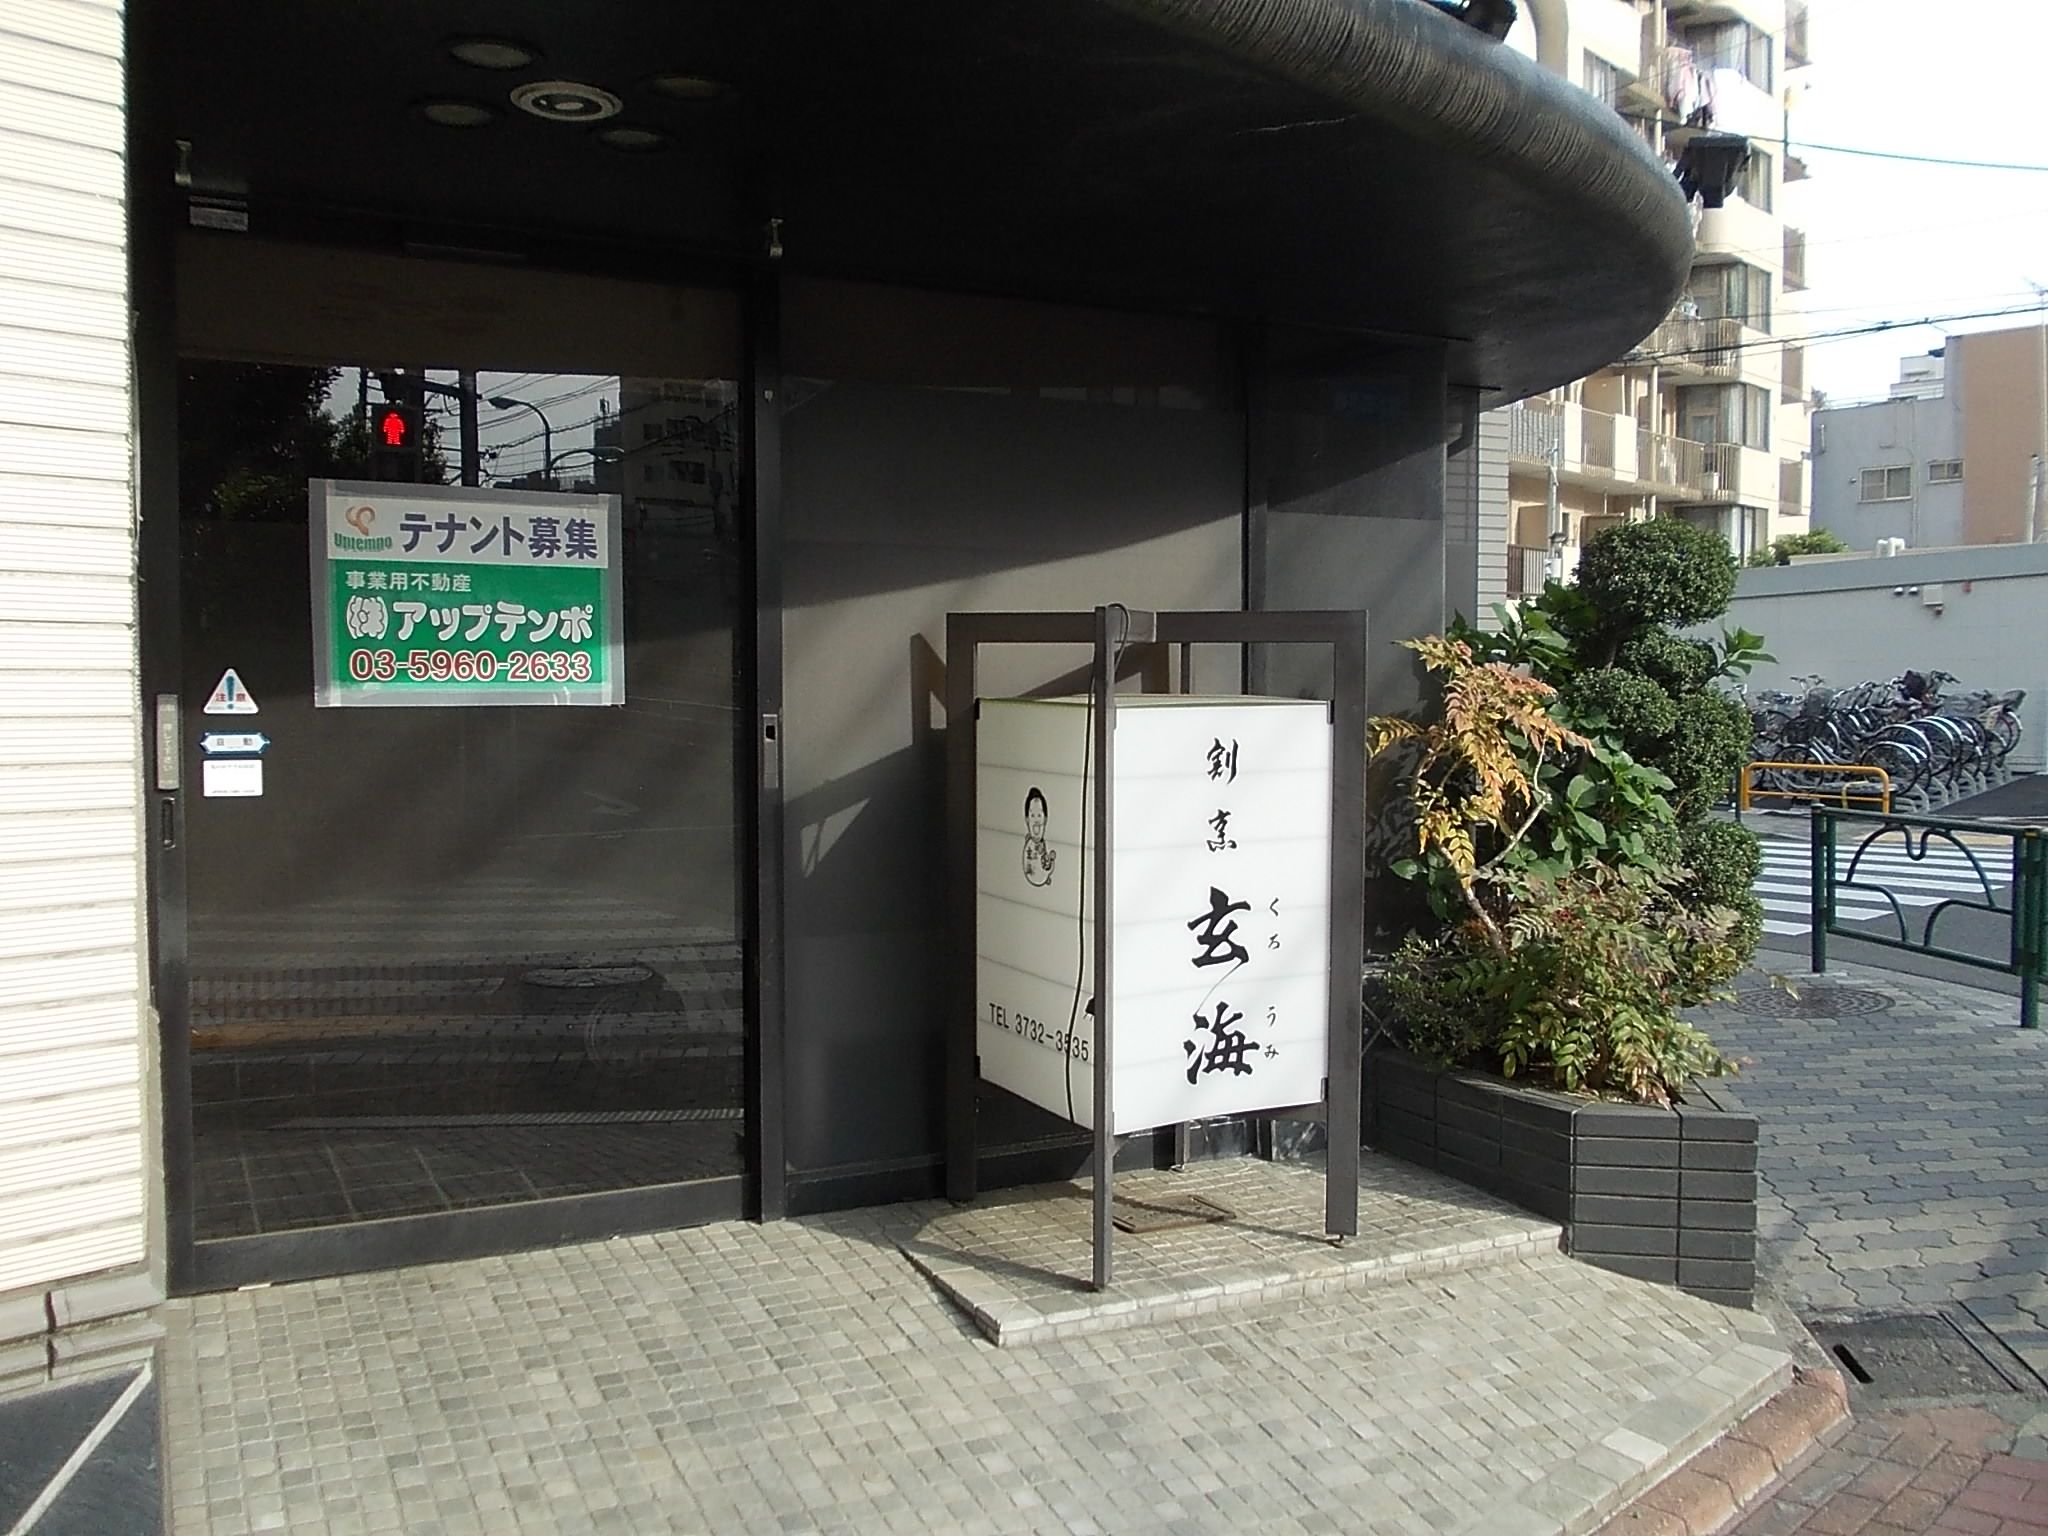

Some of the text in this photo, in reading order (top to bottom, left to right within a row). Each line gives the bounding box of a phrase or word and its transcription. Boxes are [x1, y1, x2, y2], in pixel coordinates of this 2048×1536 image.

[400, 513, 599, 560] テナント募集
[345, 570, 472, 592] 事業用不動産
[349, 649, 593, 682] 03-5960-2633
[1183, 886, 1260, 1085] 玄海
[989, 1002, 1089, 1062] TEL 3732-3535
